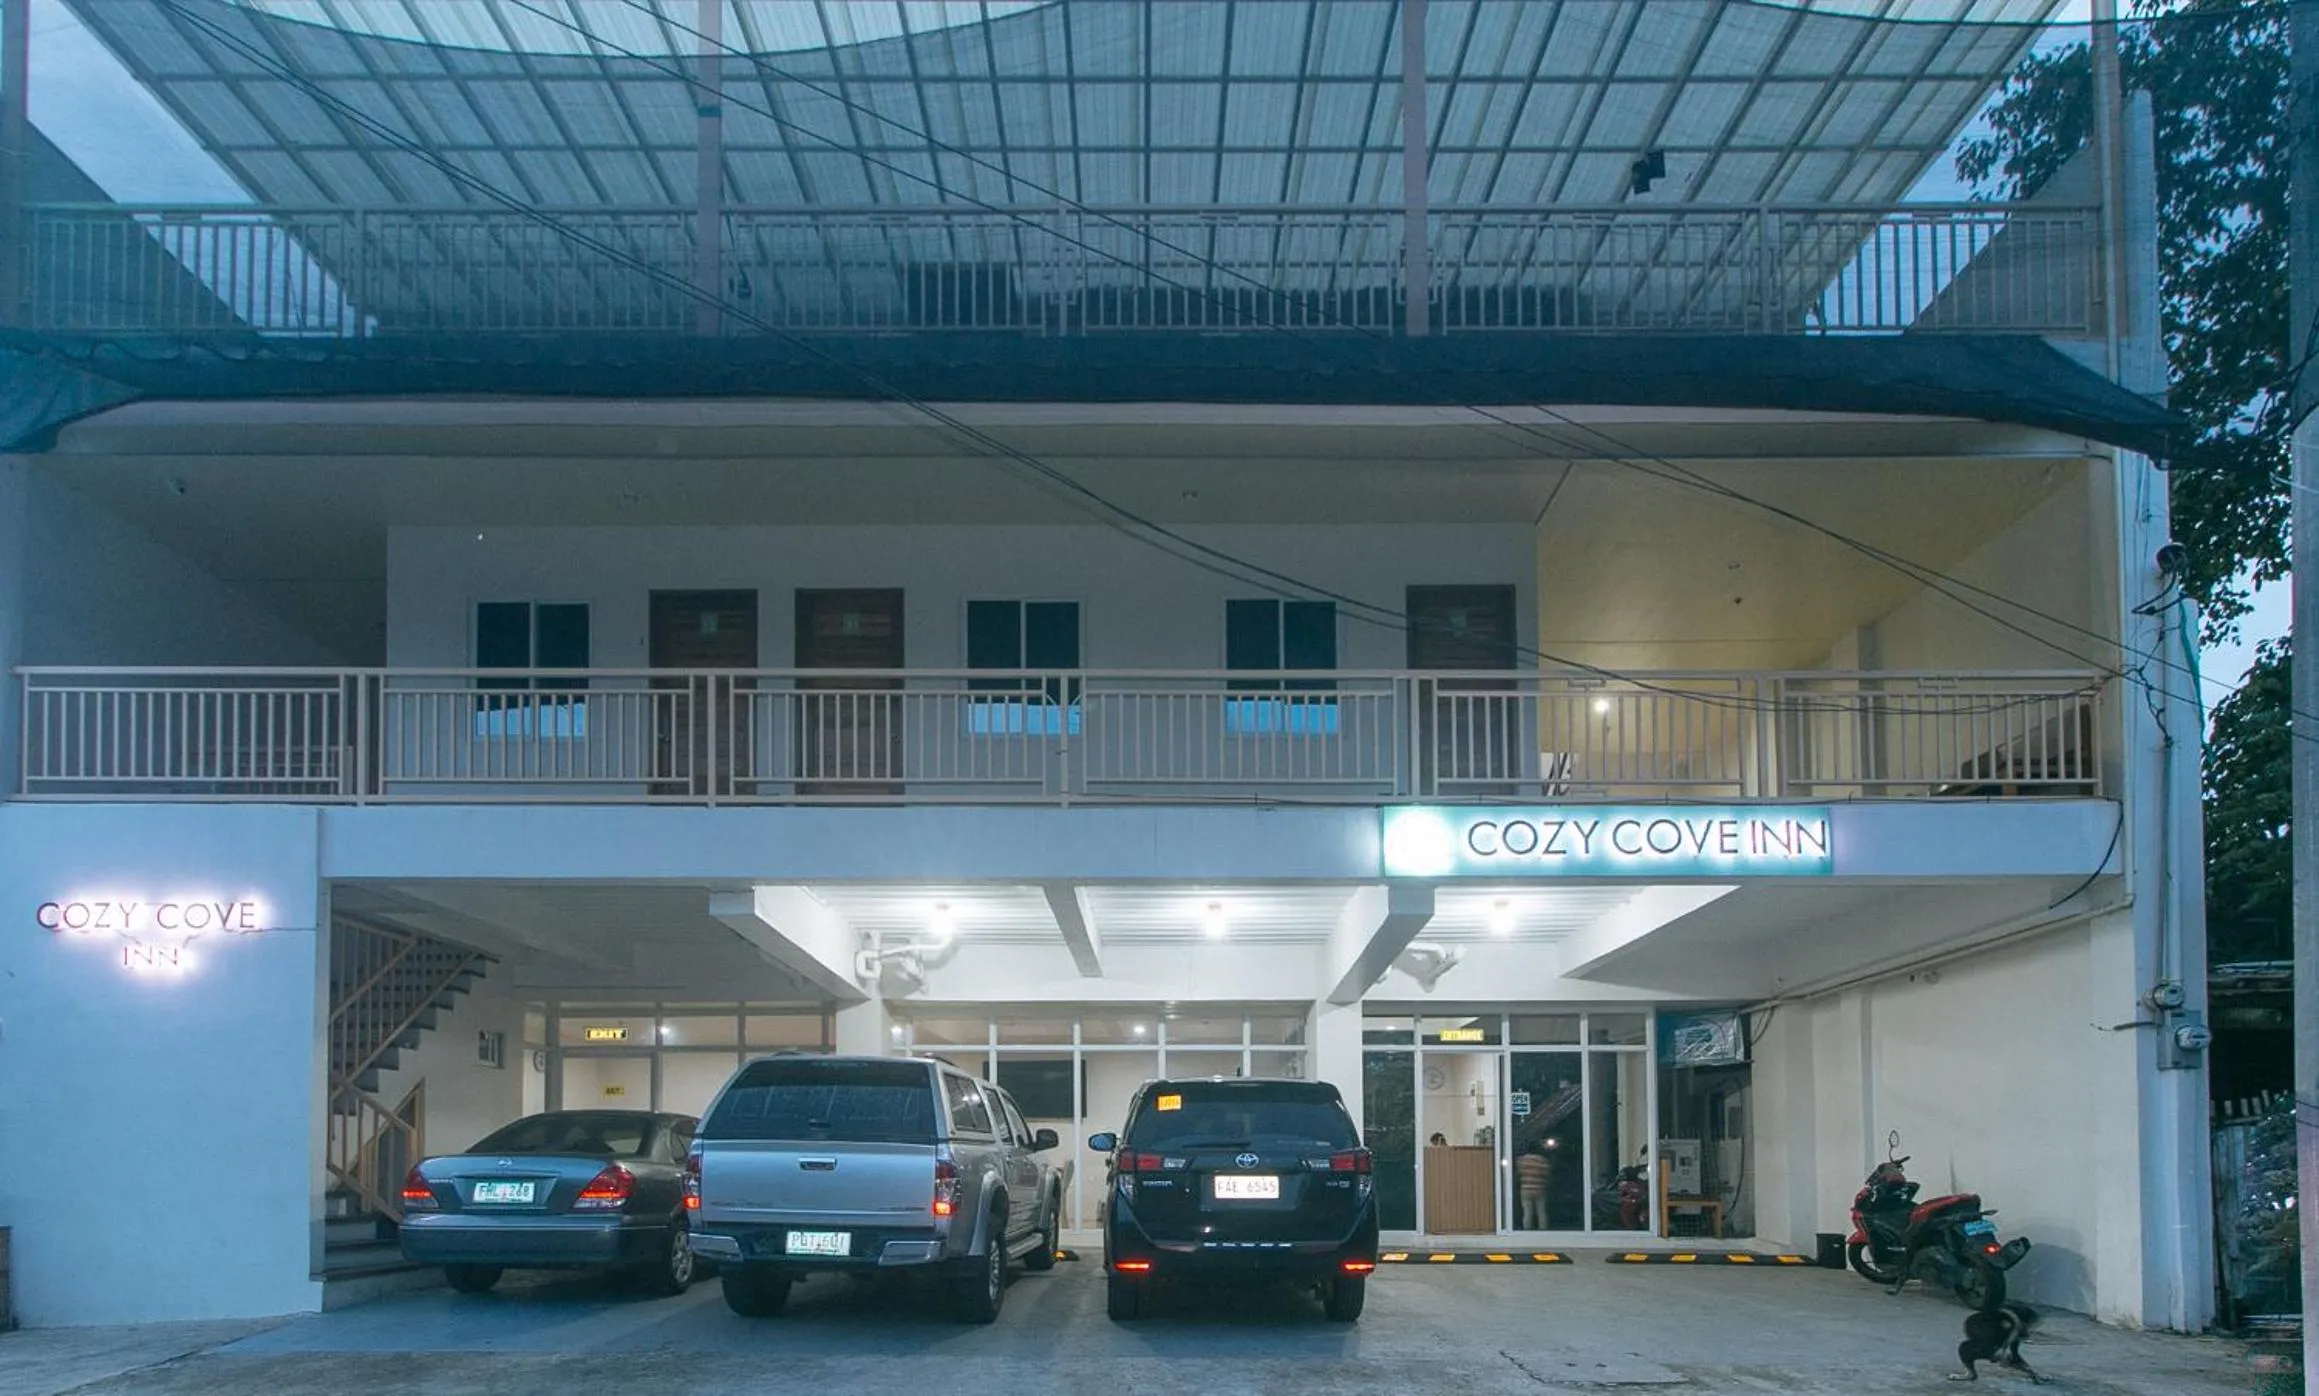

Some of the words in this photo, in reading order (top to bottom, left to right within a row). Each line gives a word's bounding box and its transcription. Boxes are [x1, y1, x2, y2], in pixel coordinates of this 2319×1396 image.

[1467, 818, 1599, 856] COZY
[1612, 819, 1738, 855] COVE
[1751, 819, 1827, 855] INN
[36, 902, 137, 929] COZY
[157, 903, 255, 929] COVE
[123, 946, 178, 967] INN
